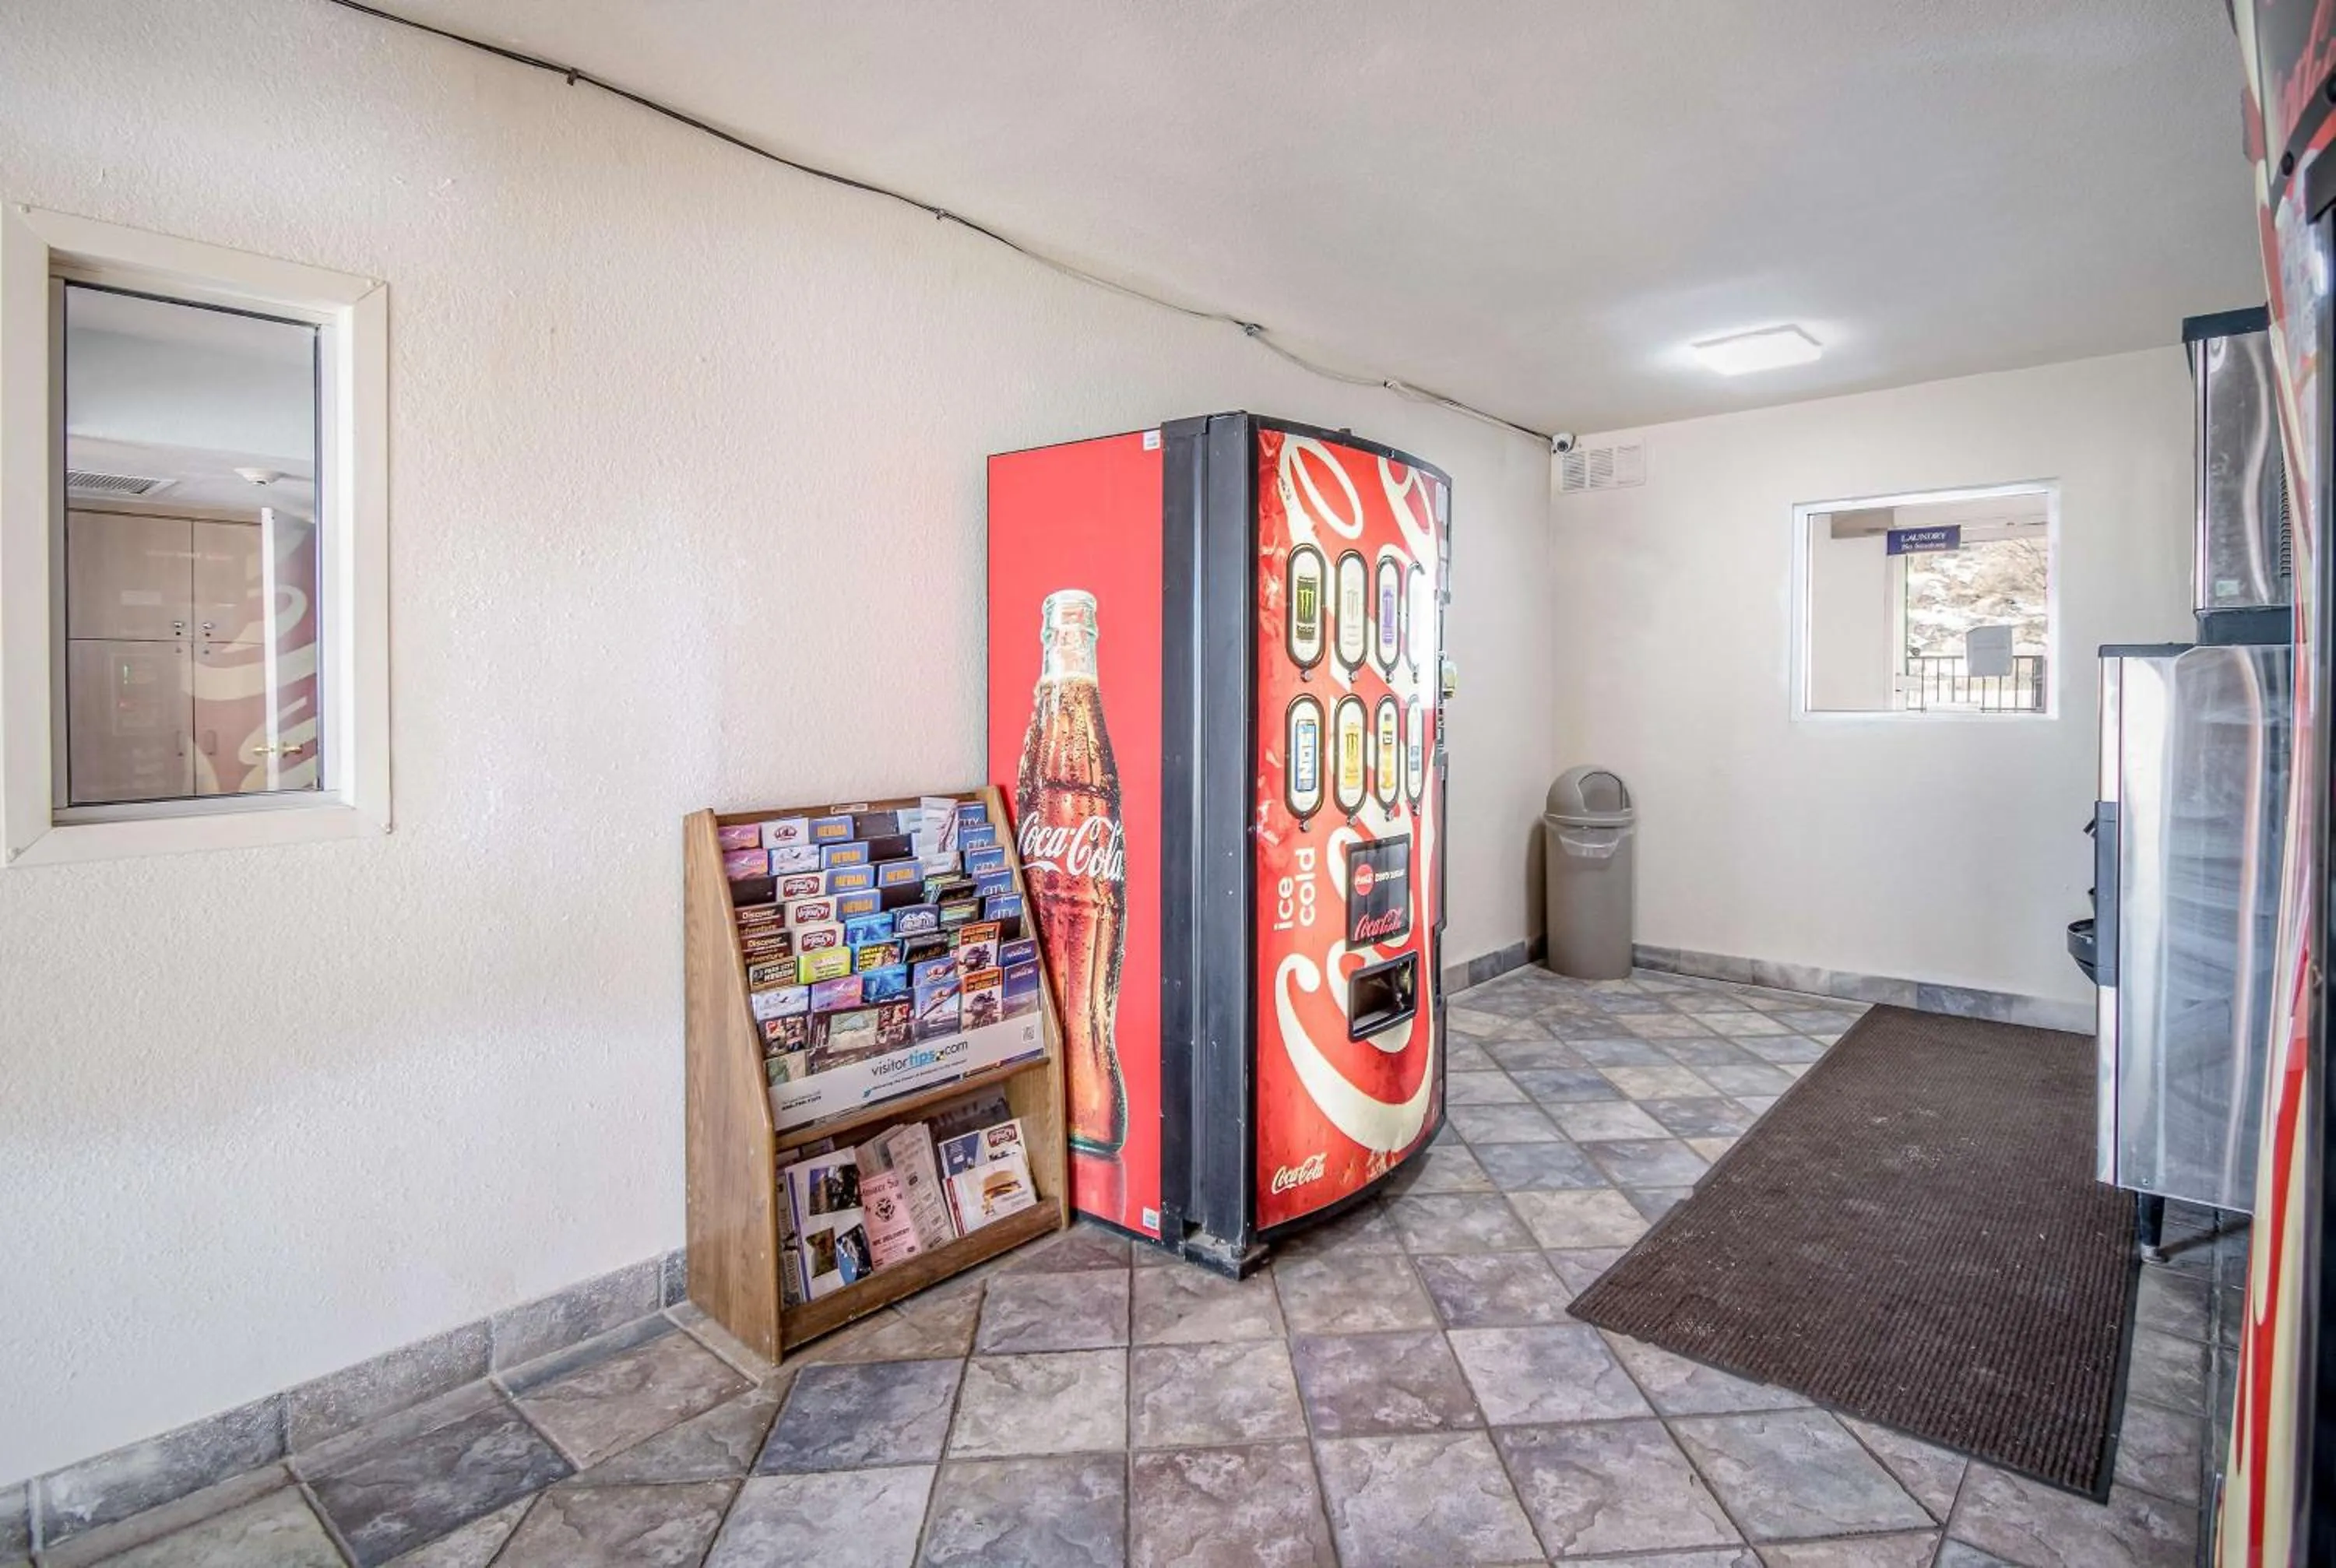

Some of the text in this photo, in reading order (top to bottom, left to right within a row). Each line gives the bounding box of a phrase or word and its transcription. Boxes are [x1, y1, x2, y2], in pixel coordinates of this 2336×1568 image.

[1901, 533, 1946, 543] LAUNDRY
[1274, 877, 1293, 930] ice
[1295, 847, 1315, 926] cold
